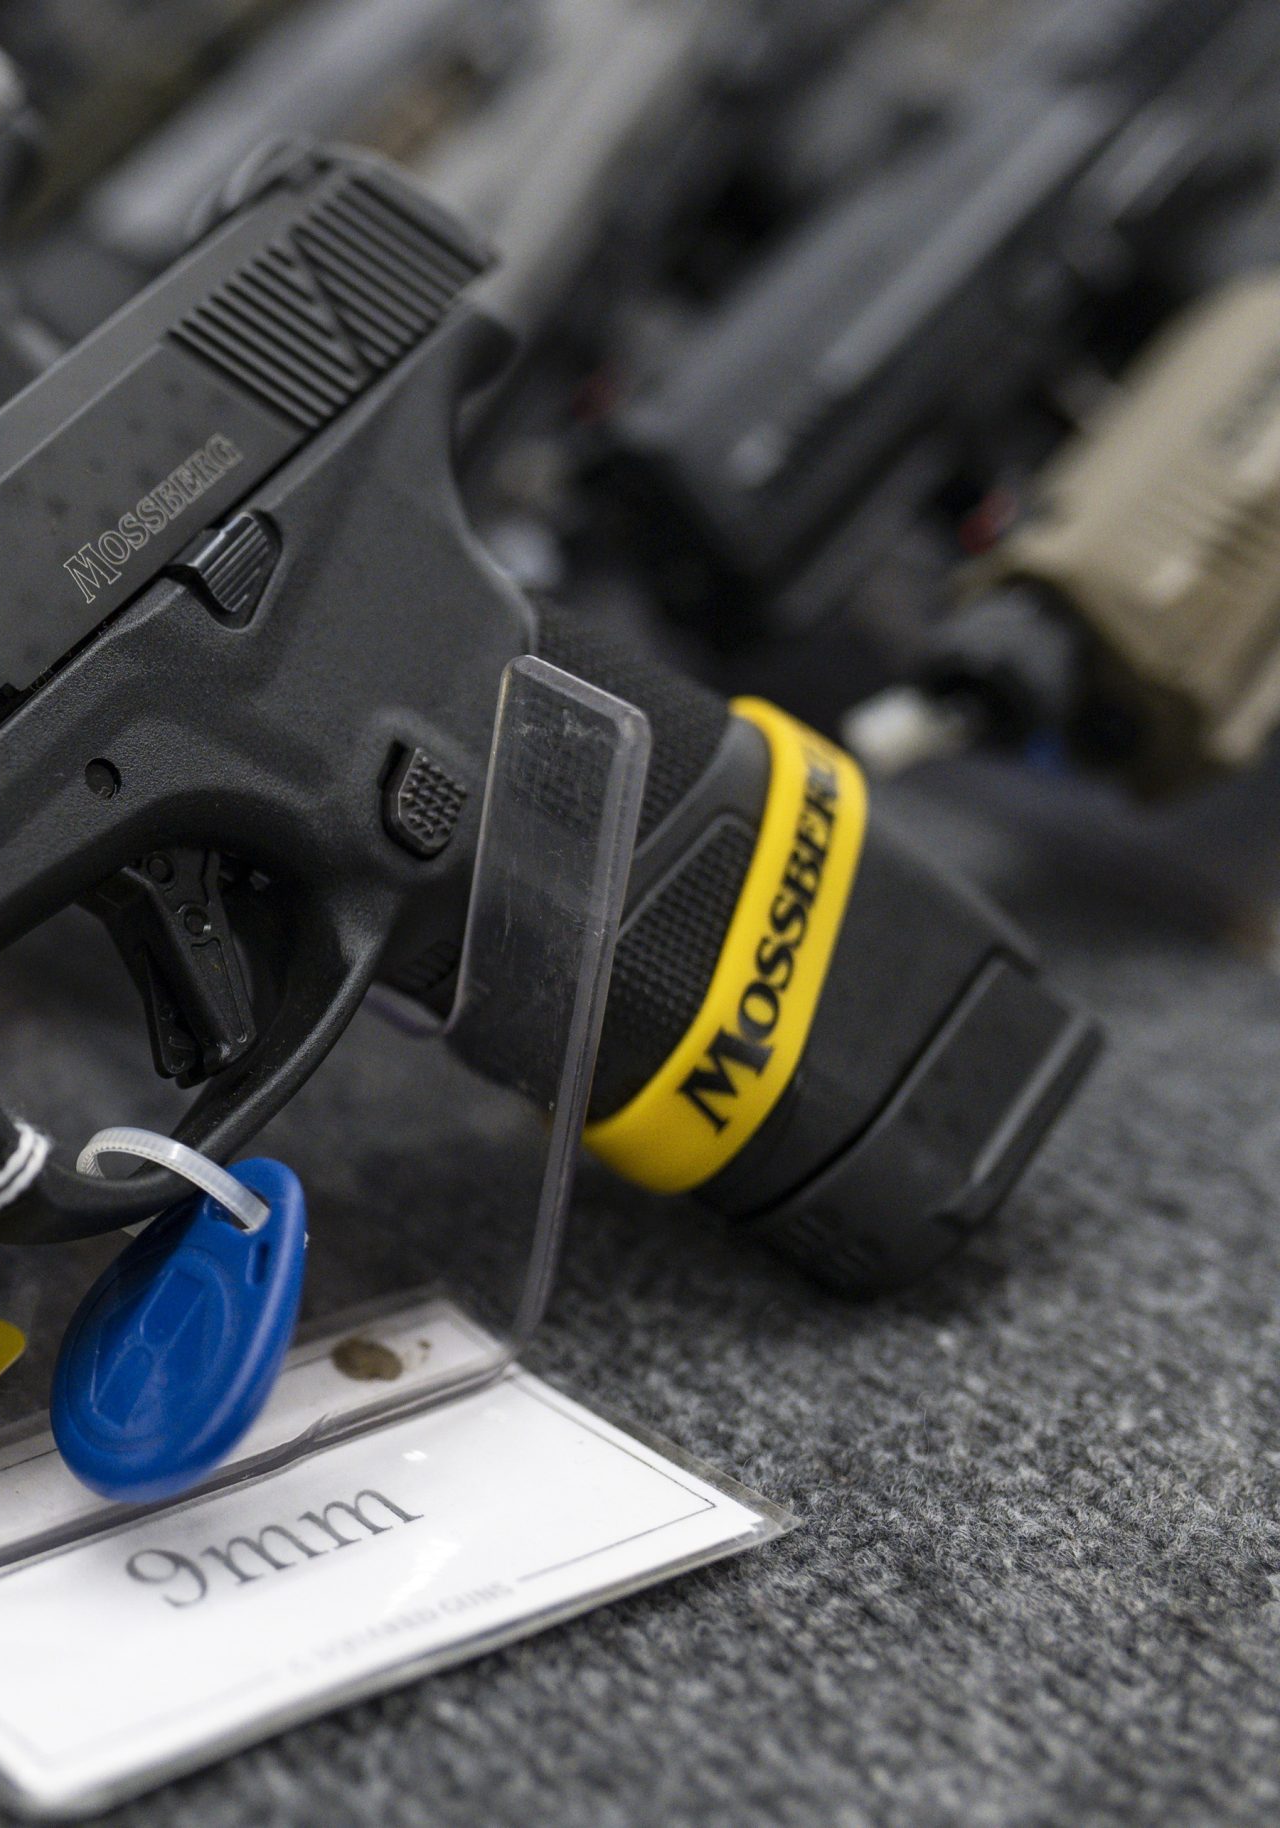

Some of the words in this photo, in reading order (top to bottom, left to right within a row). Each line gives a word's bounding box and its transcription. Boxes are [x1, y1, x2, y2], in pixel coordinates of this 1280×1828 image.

[63, 432, 244, 604] MOSSBERG
[677, 748, 840, 1135] MOSSBER
[124, 1488, 424, 1609] 9mm
